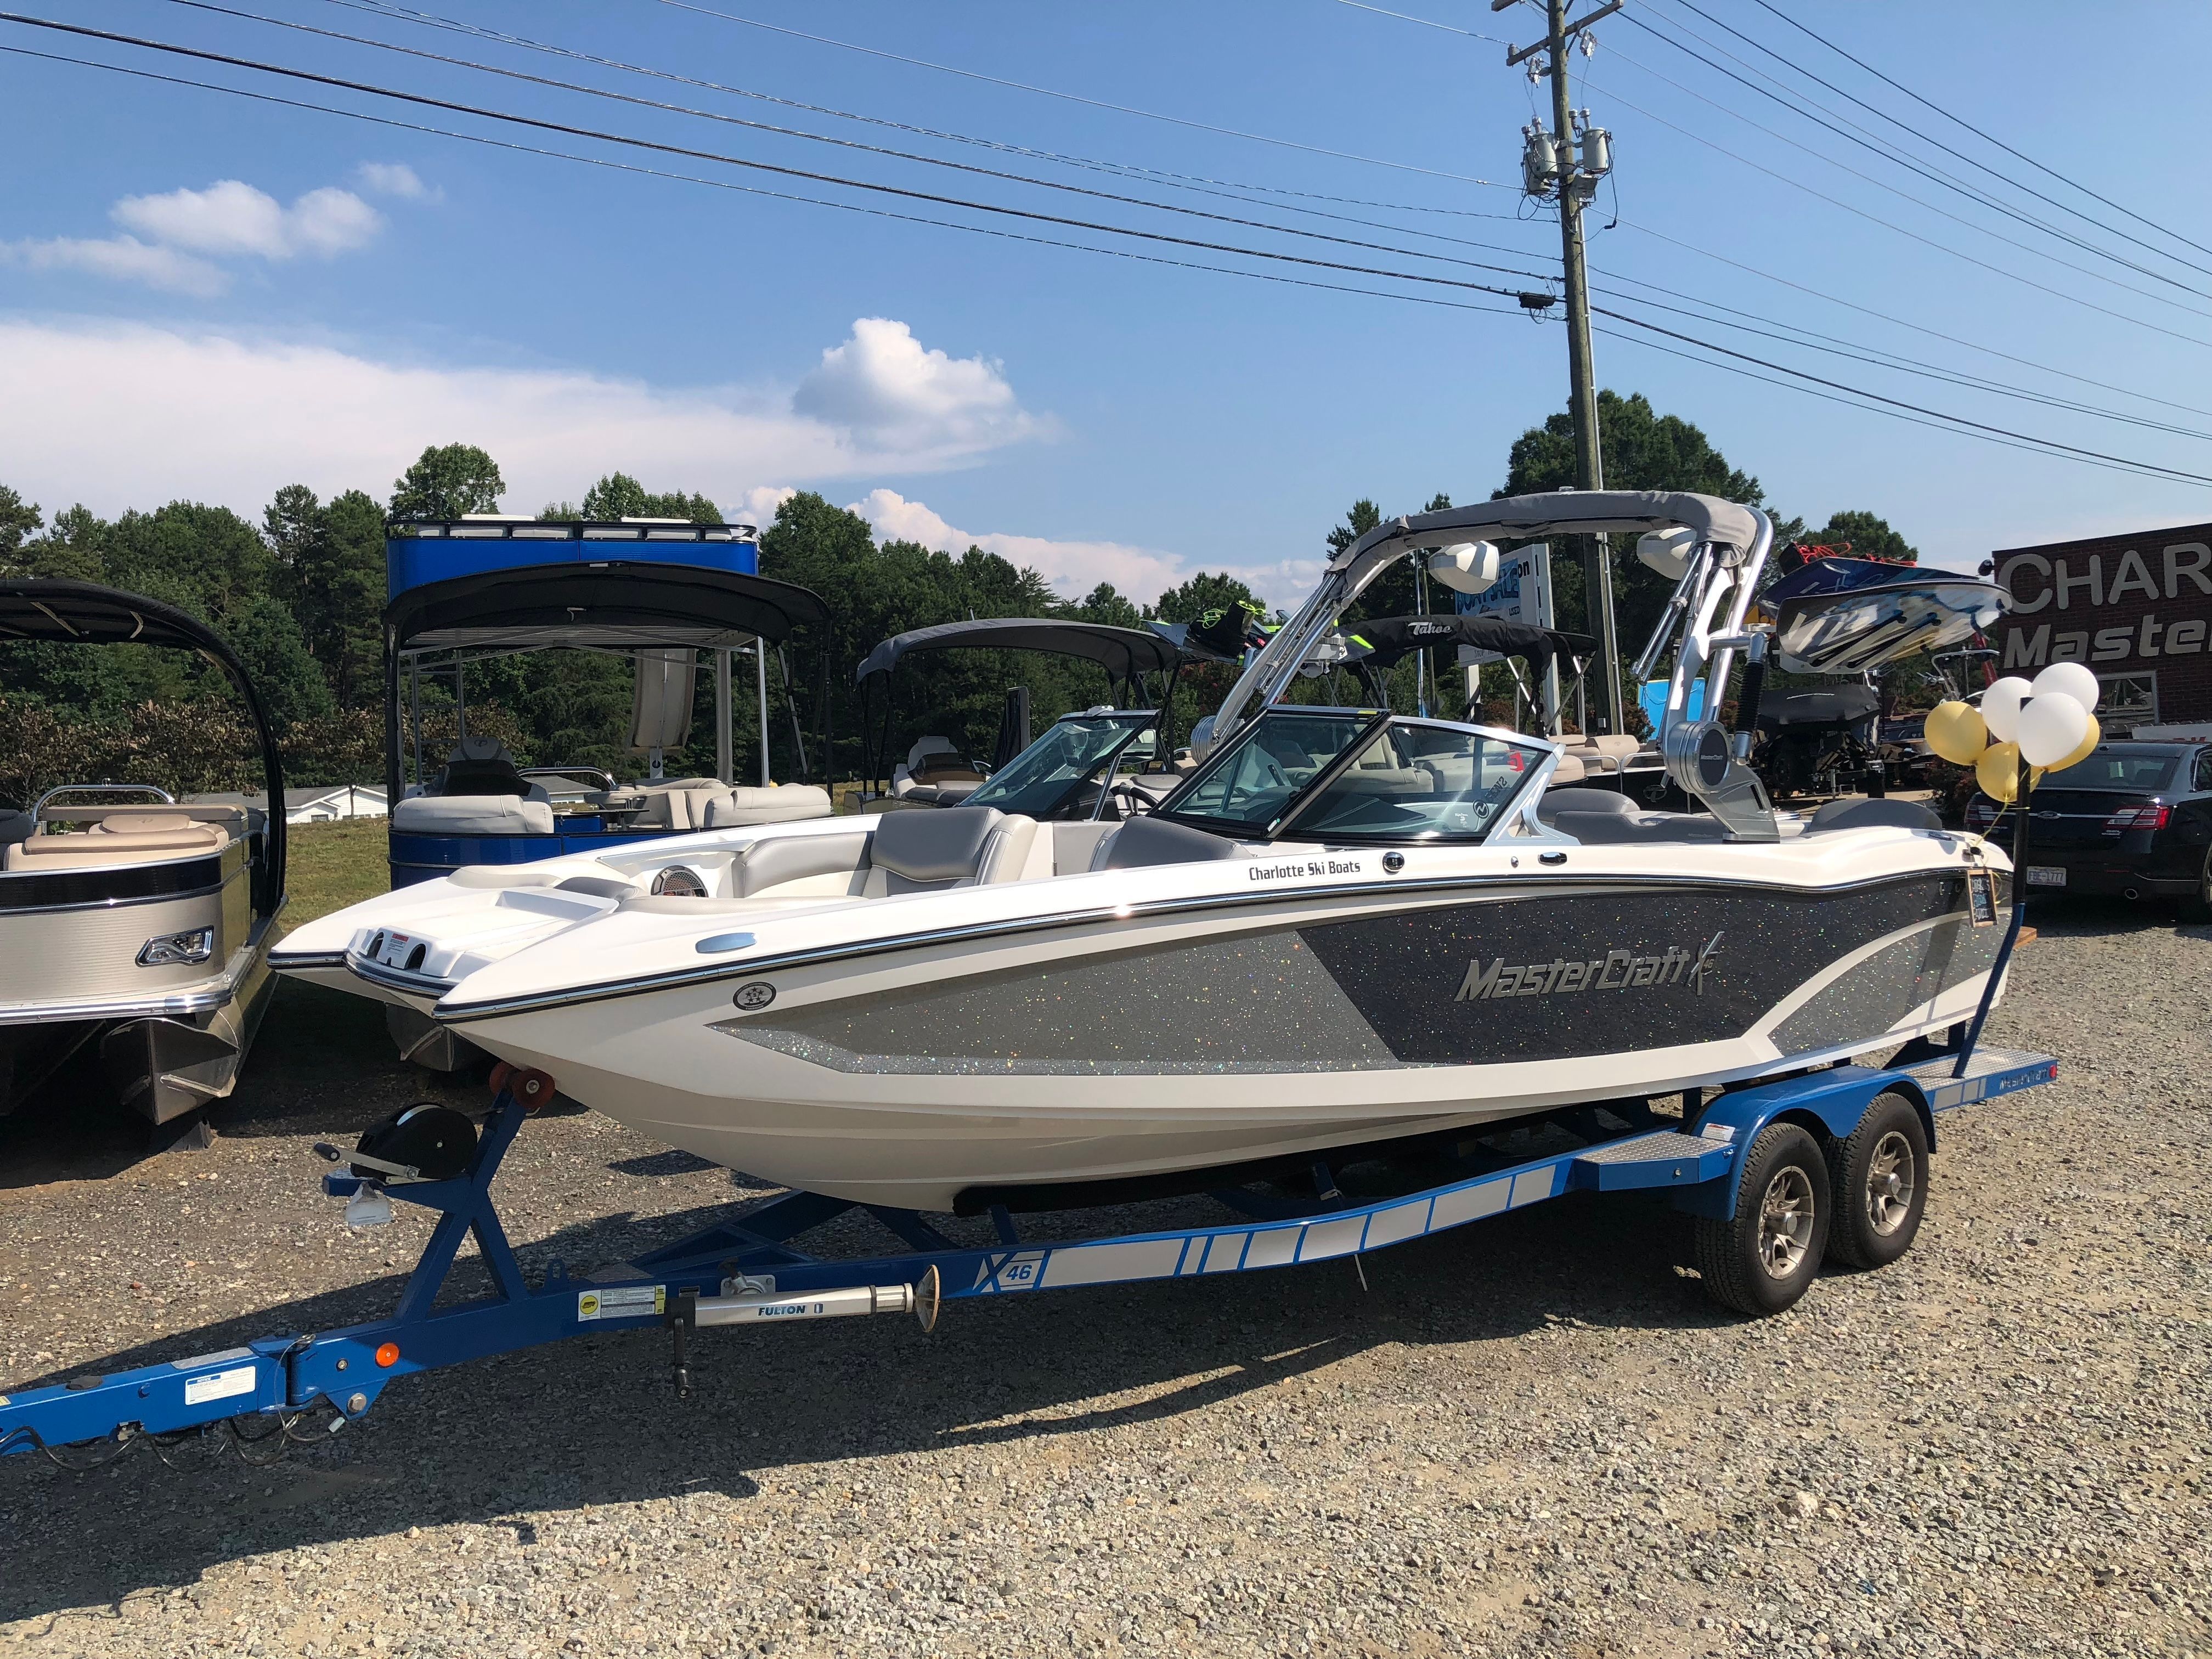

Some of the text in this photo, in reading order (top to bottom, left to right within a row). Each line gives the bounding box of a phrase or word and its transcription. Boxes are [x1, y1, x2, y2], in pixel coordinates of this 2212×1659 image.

[1997, 543, 2212, 614] CHAR
[1408, 622, 1452, 635] Tahoe
[2004, 614, 2212, 668] Maste
[1249, 861, 1361, 881] Charlotte Ski Boats
[1453, 946, 1690, 1002] MasterCraft
[758, 1305, 805, 1316] FULTON
